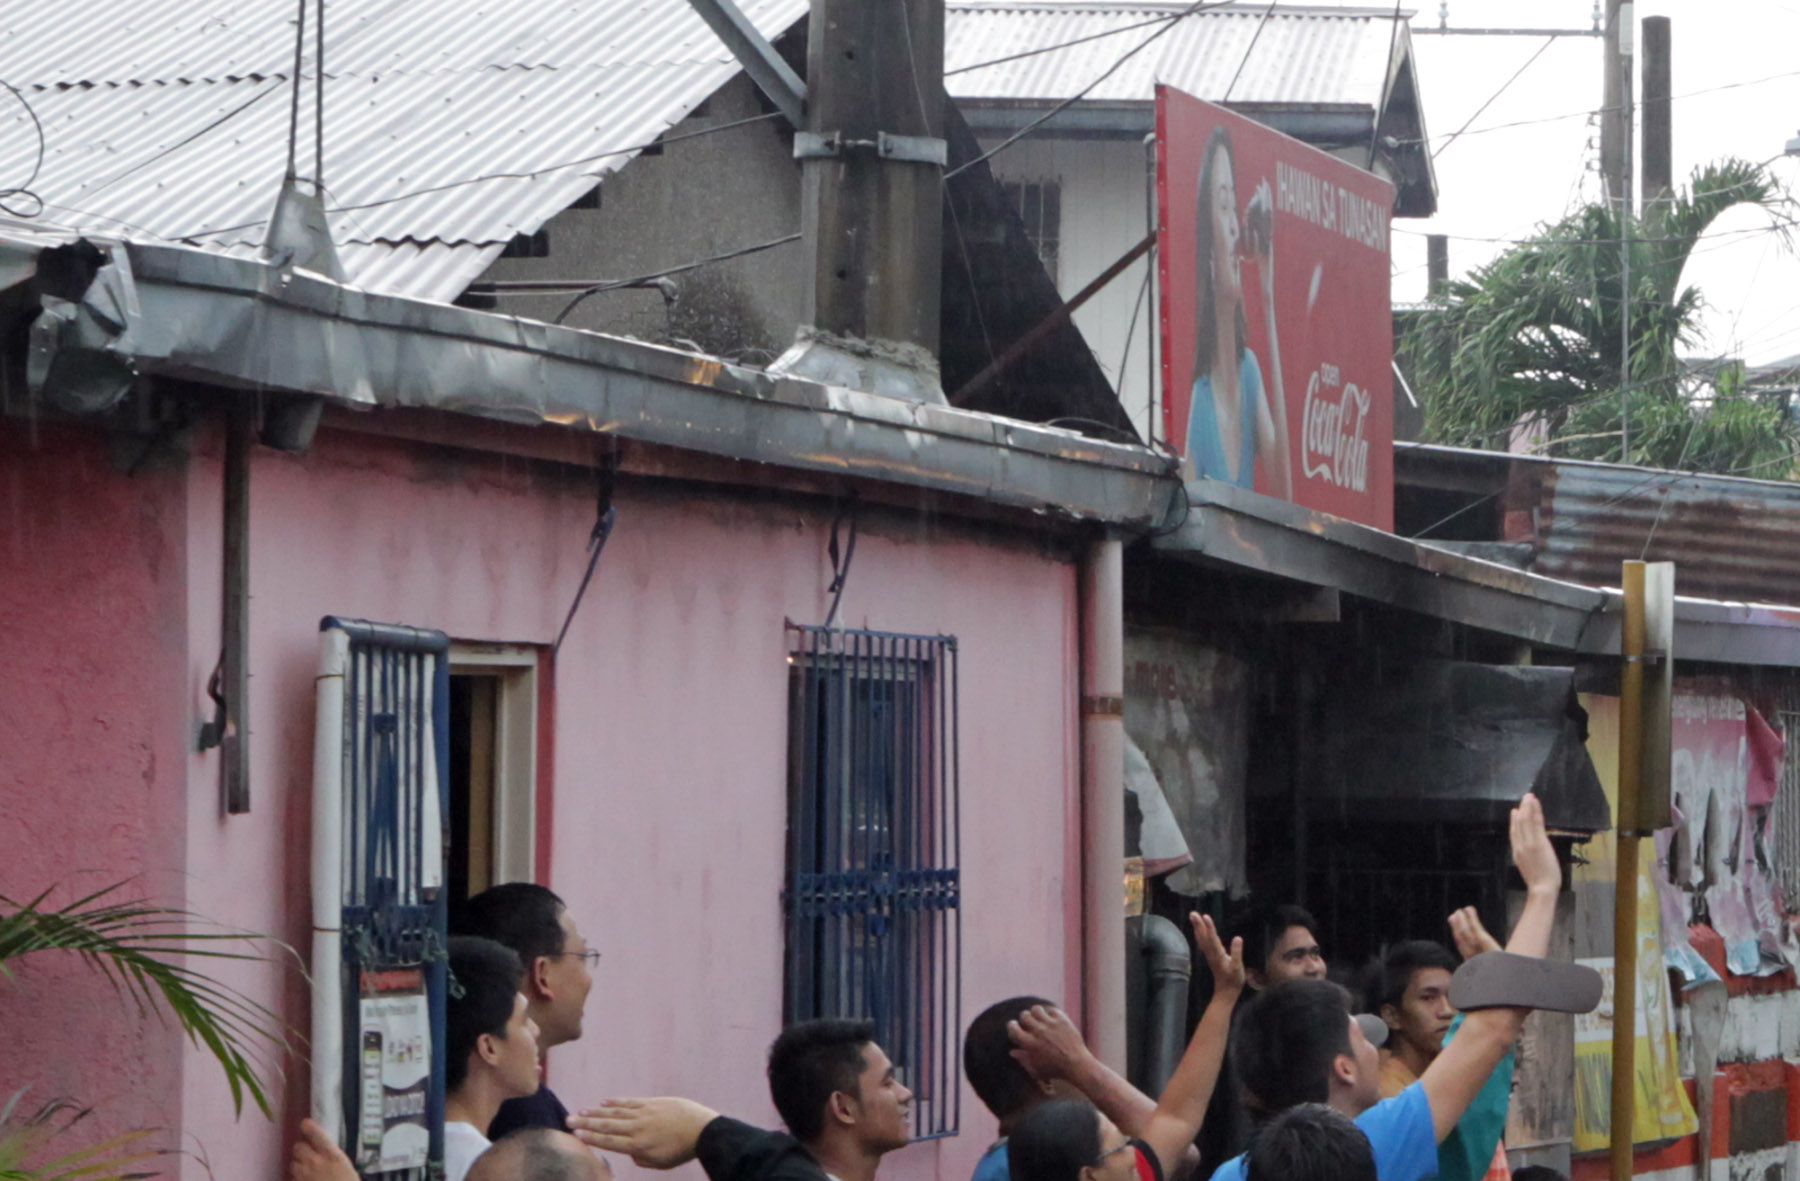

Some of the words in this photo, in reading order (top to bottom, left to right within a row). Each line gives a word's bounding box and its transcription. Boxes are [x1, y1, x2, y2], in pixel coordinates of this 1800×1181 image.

[1276, 160, 1321, 226] IHAWAN
[1322, 180, 1338, 232] SA
[1338, 186, 1388, 253] TUNASAN
